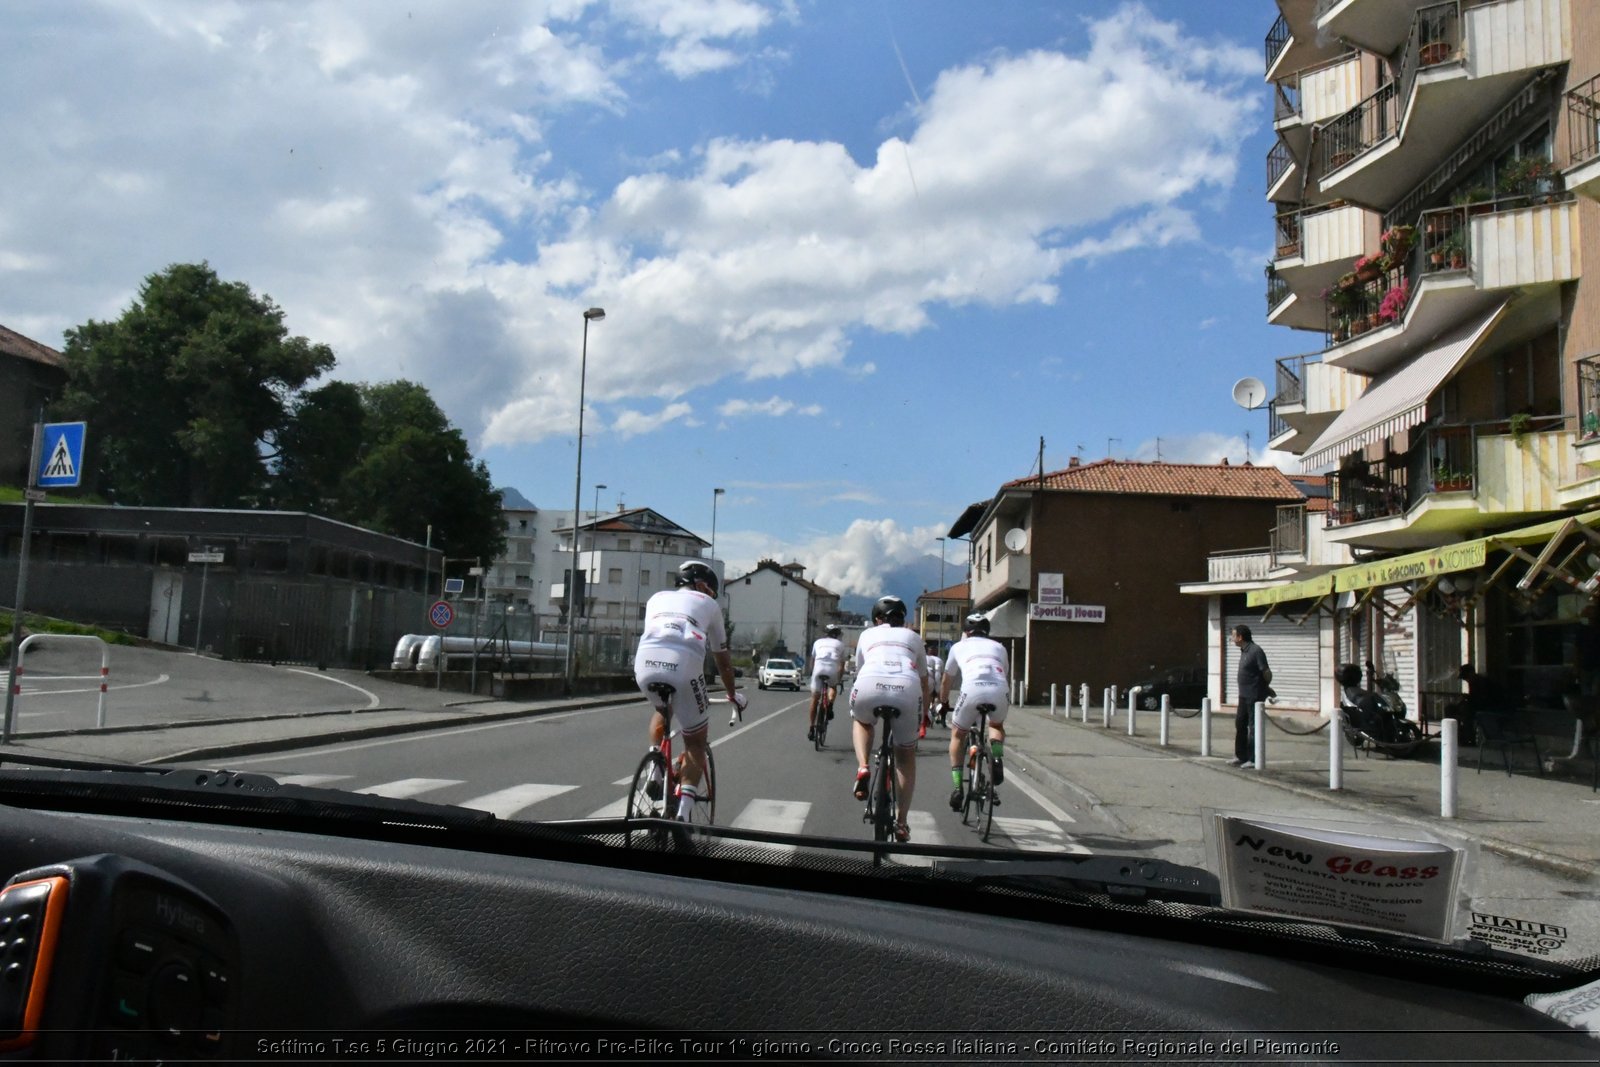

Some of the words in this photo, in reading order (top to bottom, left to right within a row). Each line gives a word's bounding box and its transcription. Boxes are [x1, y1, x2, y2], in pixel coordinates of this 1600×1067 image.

[1445, 545, 1485, 569] SCOMMESSE
[1033, 605, 1072, 619] Sporting
[645, 660, 679, 669] FACTORY
[876, 682, 905, 690] FACTORY
[1235, 834, 1313, 865] New
[1326, 856, 1439, 879] Glass
[1252, 856, 1338, 880] SPECIALISTA
[1341, 876, 1381, 888] VETRI
[1350, 893, 1424, 905] riparazione
[156, 893, 205, 933] Hytera
